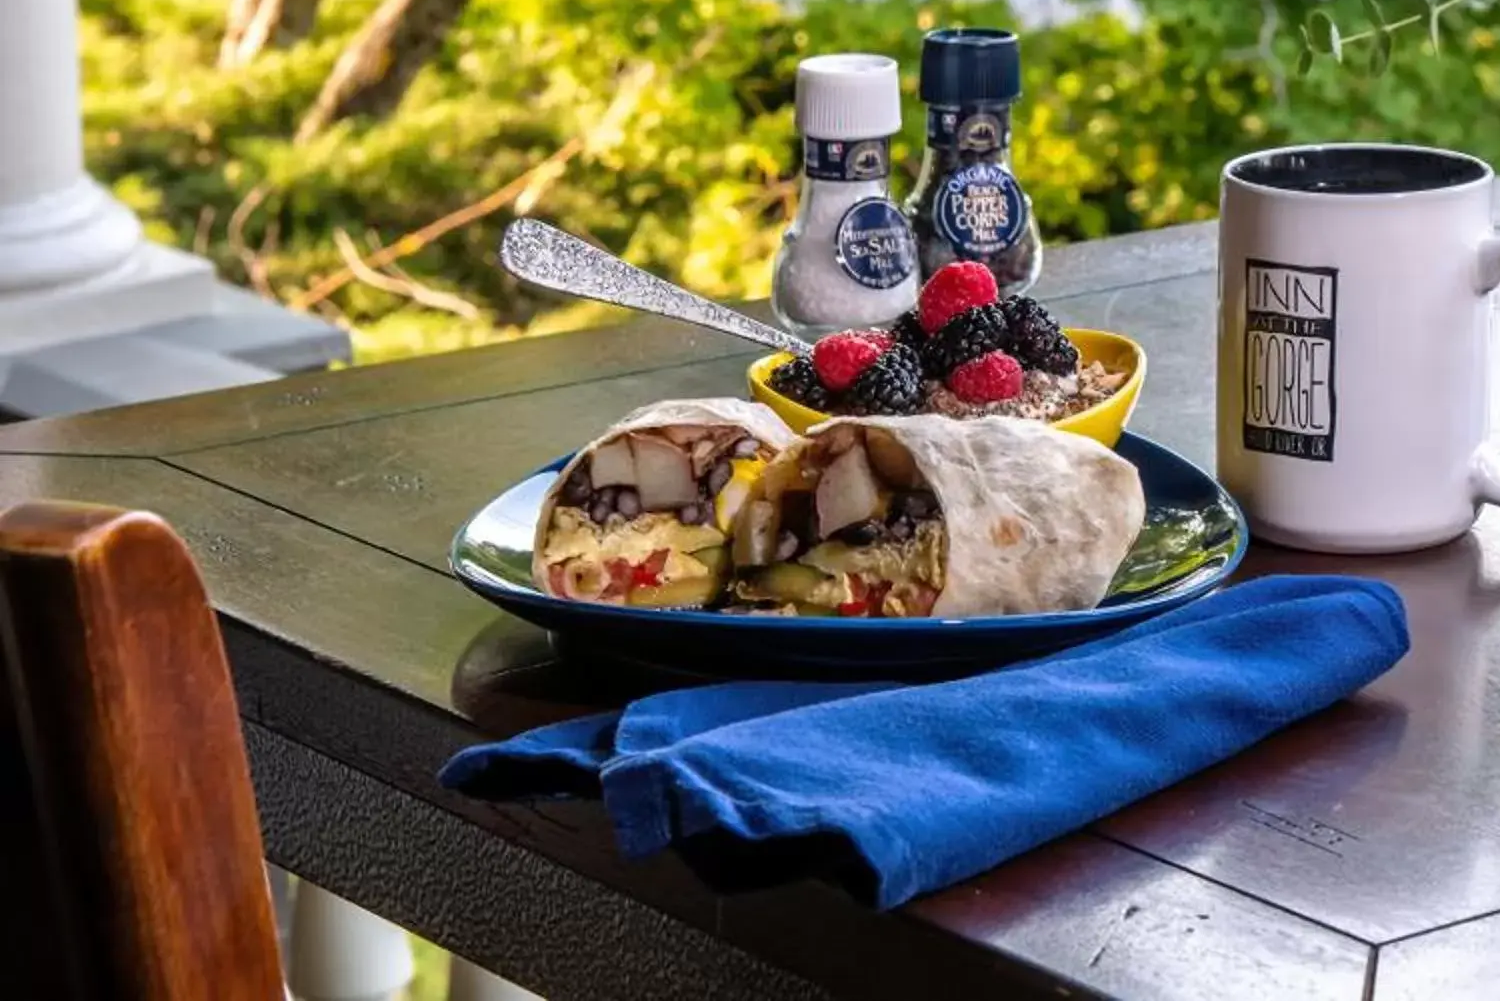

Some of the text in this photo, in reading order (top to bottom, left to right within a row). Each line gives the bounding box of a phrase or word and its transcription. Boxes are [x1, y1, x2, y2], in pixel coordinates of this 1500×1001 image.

[948, 163, 1011, 193] ORGANIC
[951, 194, 1009, 215] PEPPER
[955, 212, 1009, 230] CORNS
[1255, 270, 1325, 314] INN
[1255, 315, 1322, 336] AT THE
[1251, 334, 1325, 431] GORGE
